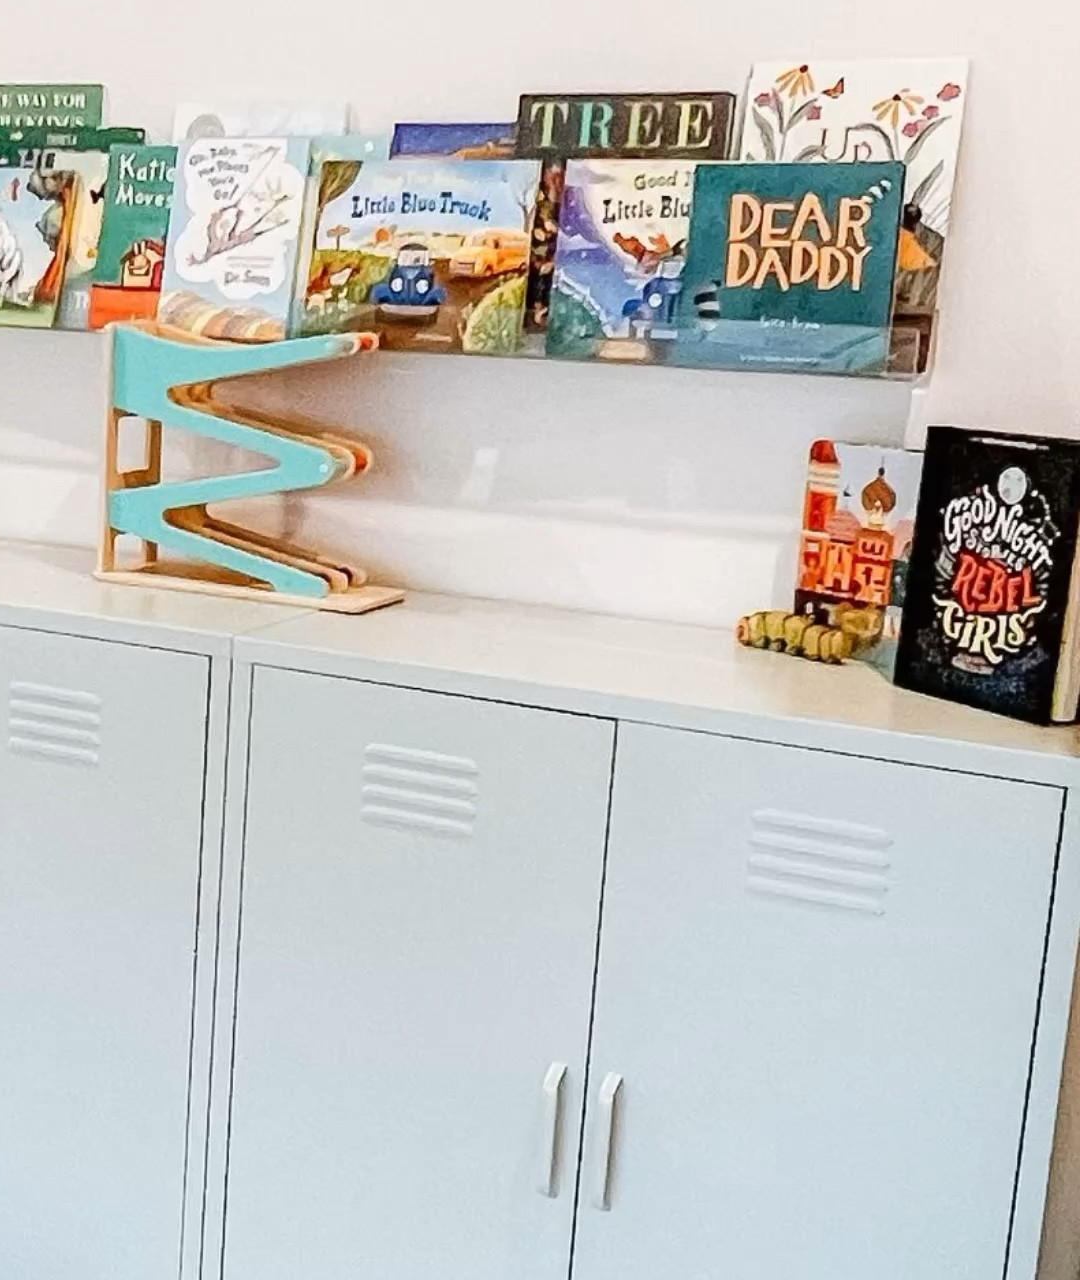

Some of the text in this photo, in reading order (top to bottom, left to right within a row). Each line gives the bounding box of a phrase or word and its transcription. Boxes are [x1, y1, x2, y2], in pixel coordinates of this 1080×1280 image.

[53, 93, 86, 108] FOR
[529, 99, 715, 150] TREE
[633, 170, 678, 191] Good
[351, 191, 492, 222] Little Blue Truck
[602, 195, 691, 224] Little Blu
[728, 191, 872, 249] DEAR
[725, 239, 873, 292] DADDY
[944, 484, 1053, 570] GOOD NIGHT
[952, 550, 1042, 613] REBEL
